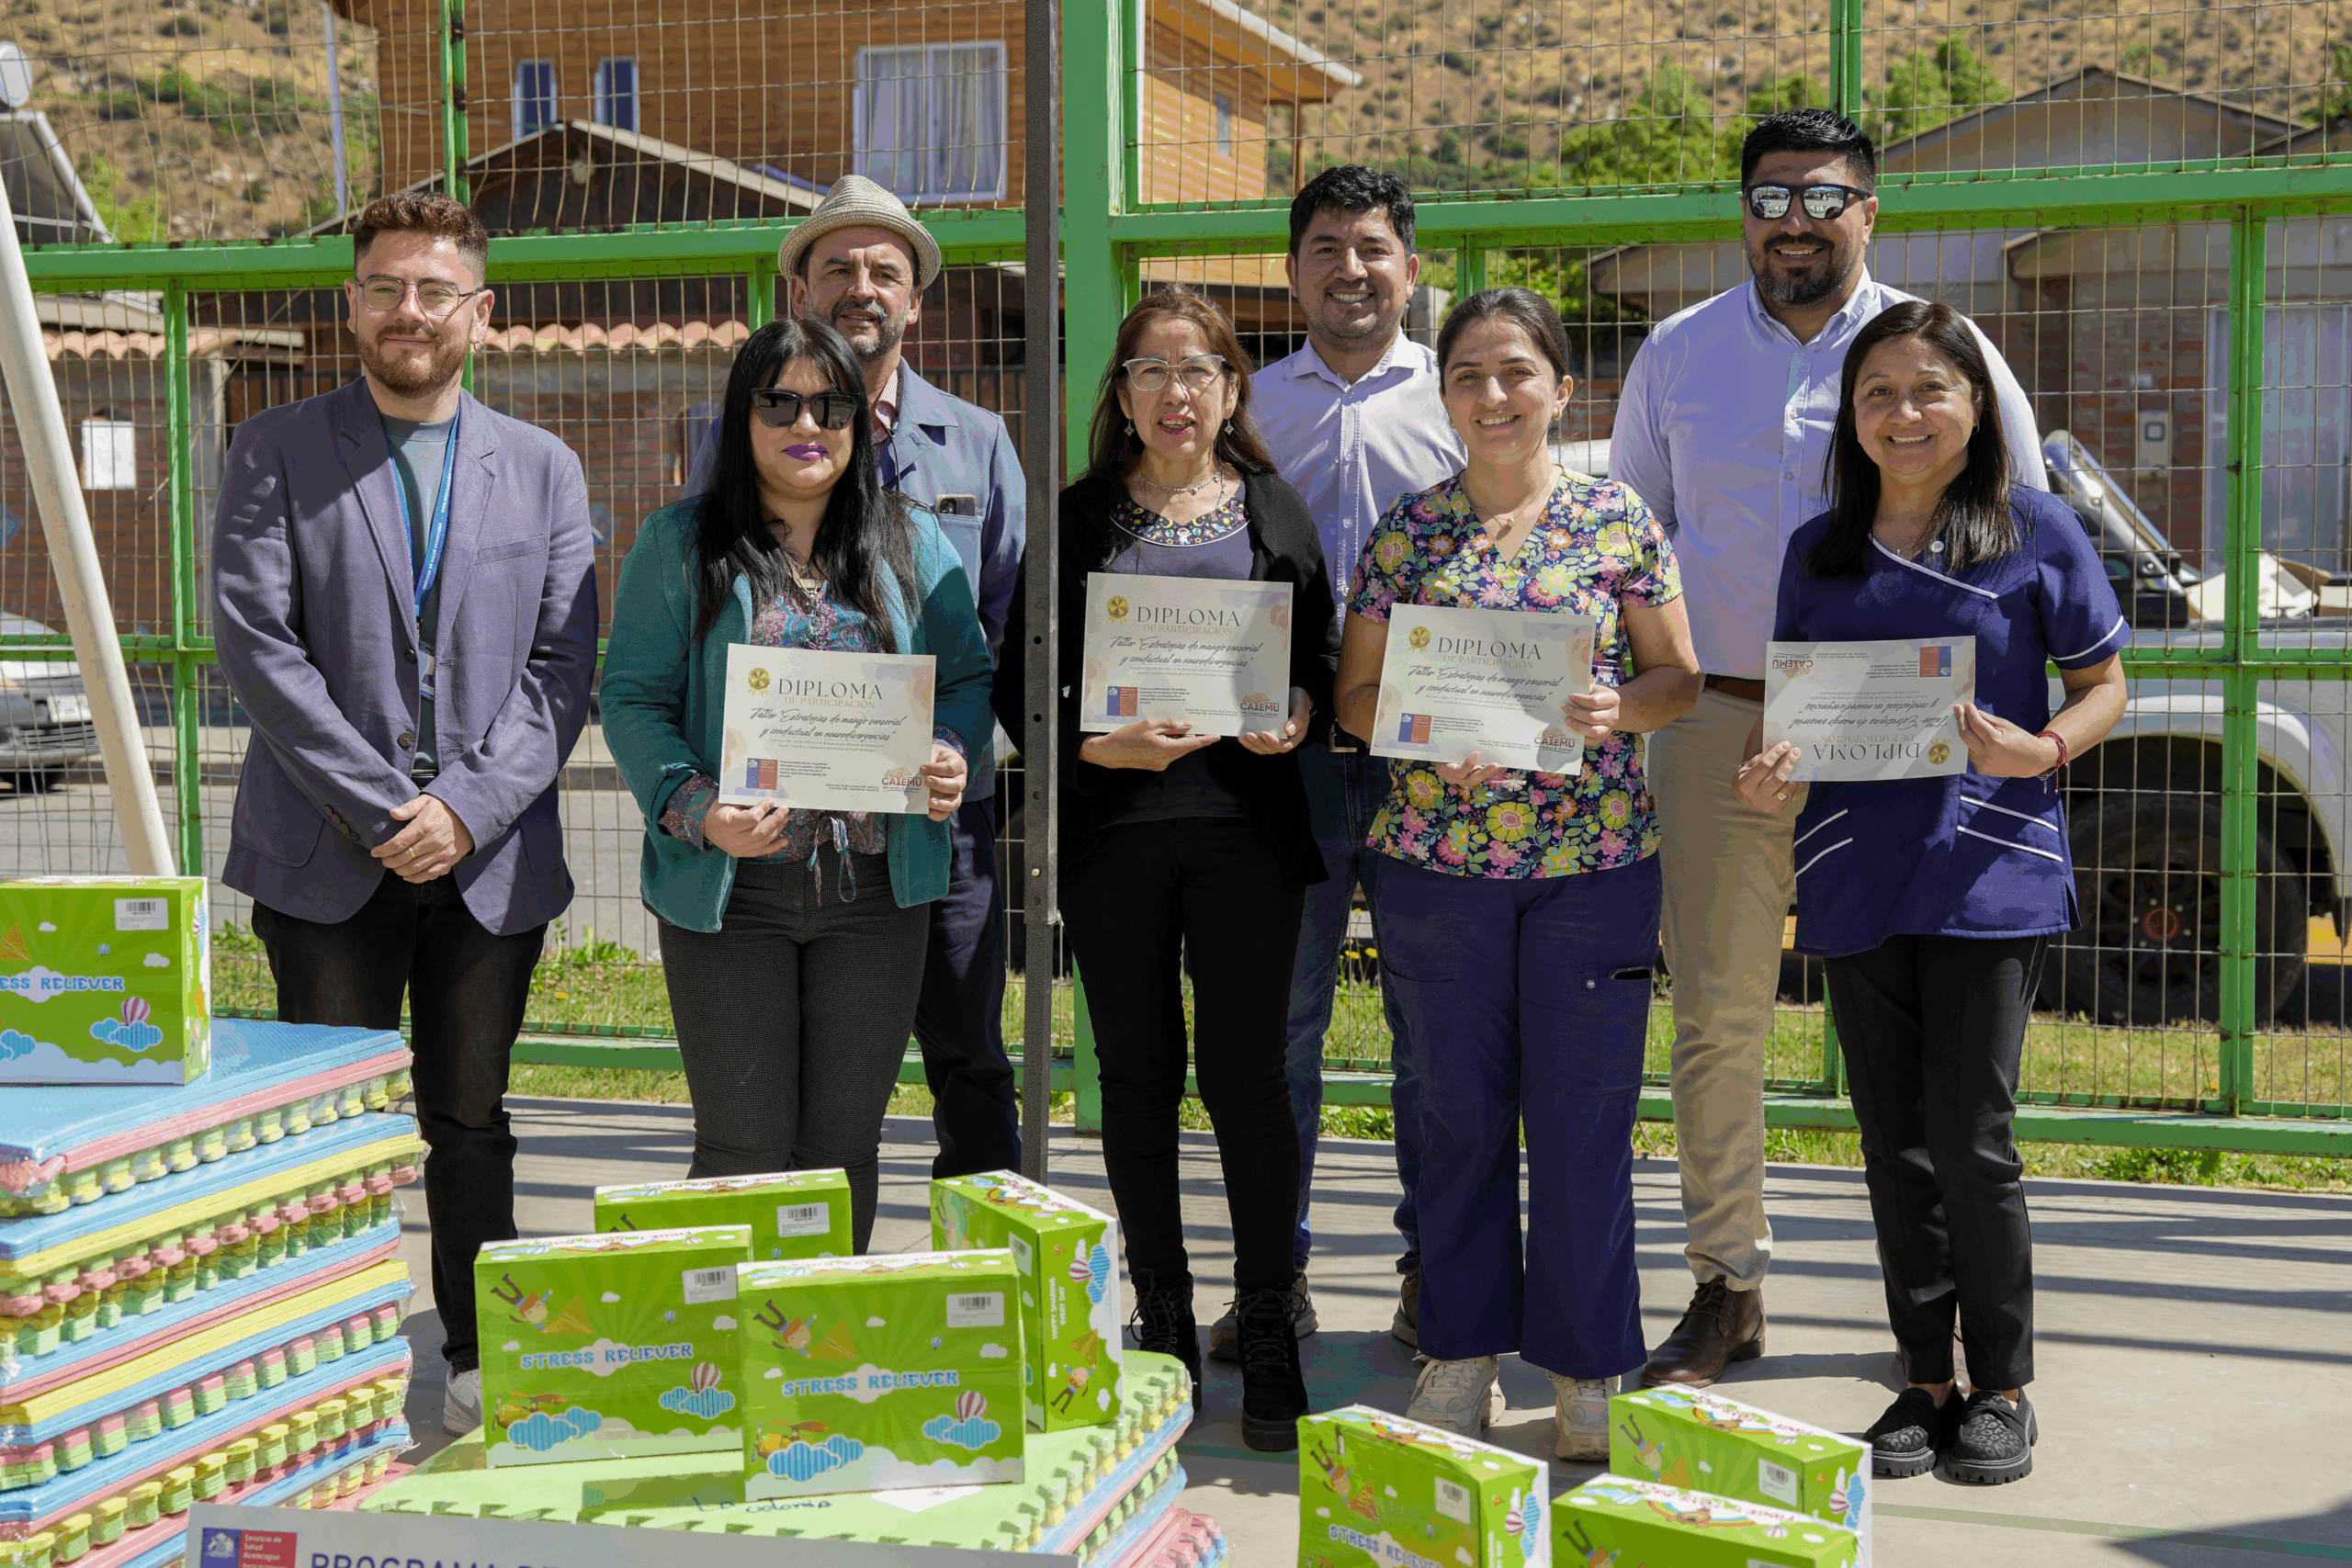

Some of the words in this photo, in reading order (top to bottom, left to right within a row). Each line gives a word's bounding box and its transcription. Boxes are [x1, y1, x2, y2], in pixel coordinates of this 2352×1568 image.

[1137, 606, 1239, 626] DIPLOMA
[1143, 624, 1157, 632] DE
[1110, 636, 1136, 649] Taller
[1438, 637, 1542, 660] DIPLOMA
[1408, 665, 1434, 677] Taller
[778, 679, 883, 700] DIPLOMA
[785, 696, 799, 705] DE
[750, 707, 777, 719] Taller
[1813, 742, 1920, 761] DIPLOMA
[40, 976, 125, 991] RELIEVER
[1050, 1314, 1058, 1340] HAPPY
[522, 1351, 594, 1369] STRESS
[605, 1343, 693, 1363] RELIEVER
[783, 1377, 858, 1396] STRESS
[867, 1371, 959, 1389] RELIEVER
[1329, 1525, 1380, 1553] STRESS
